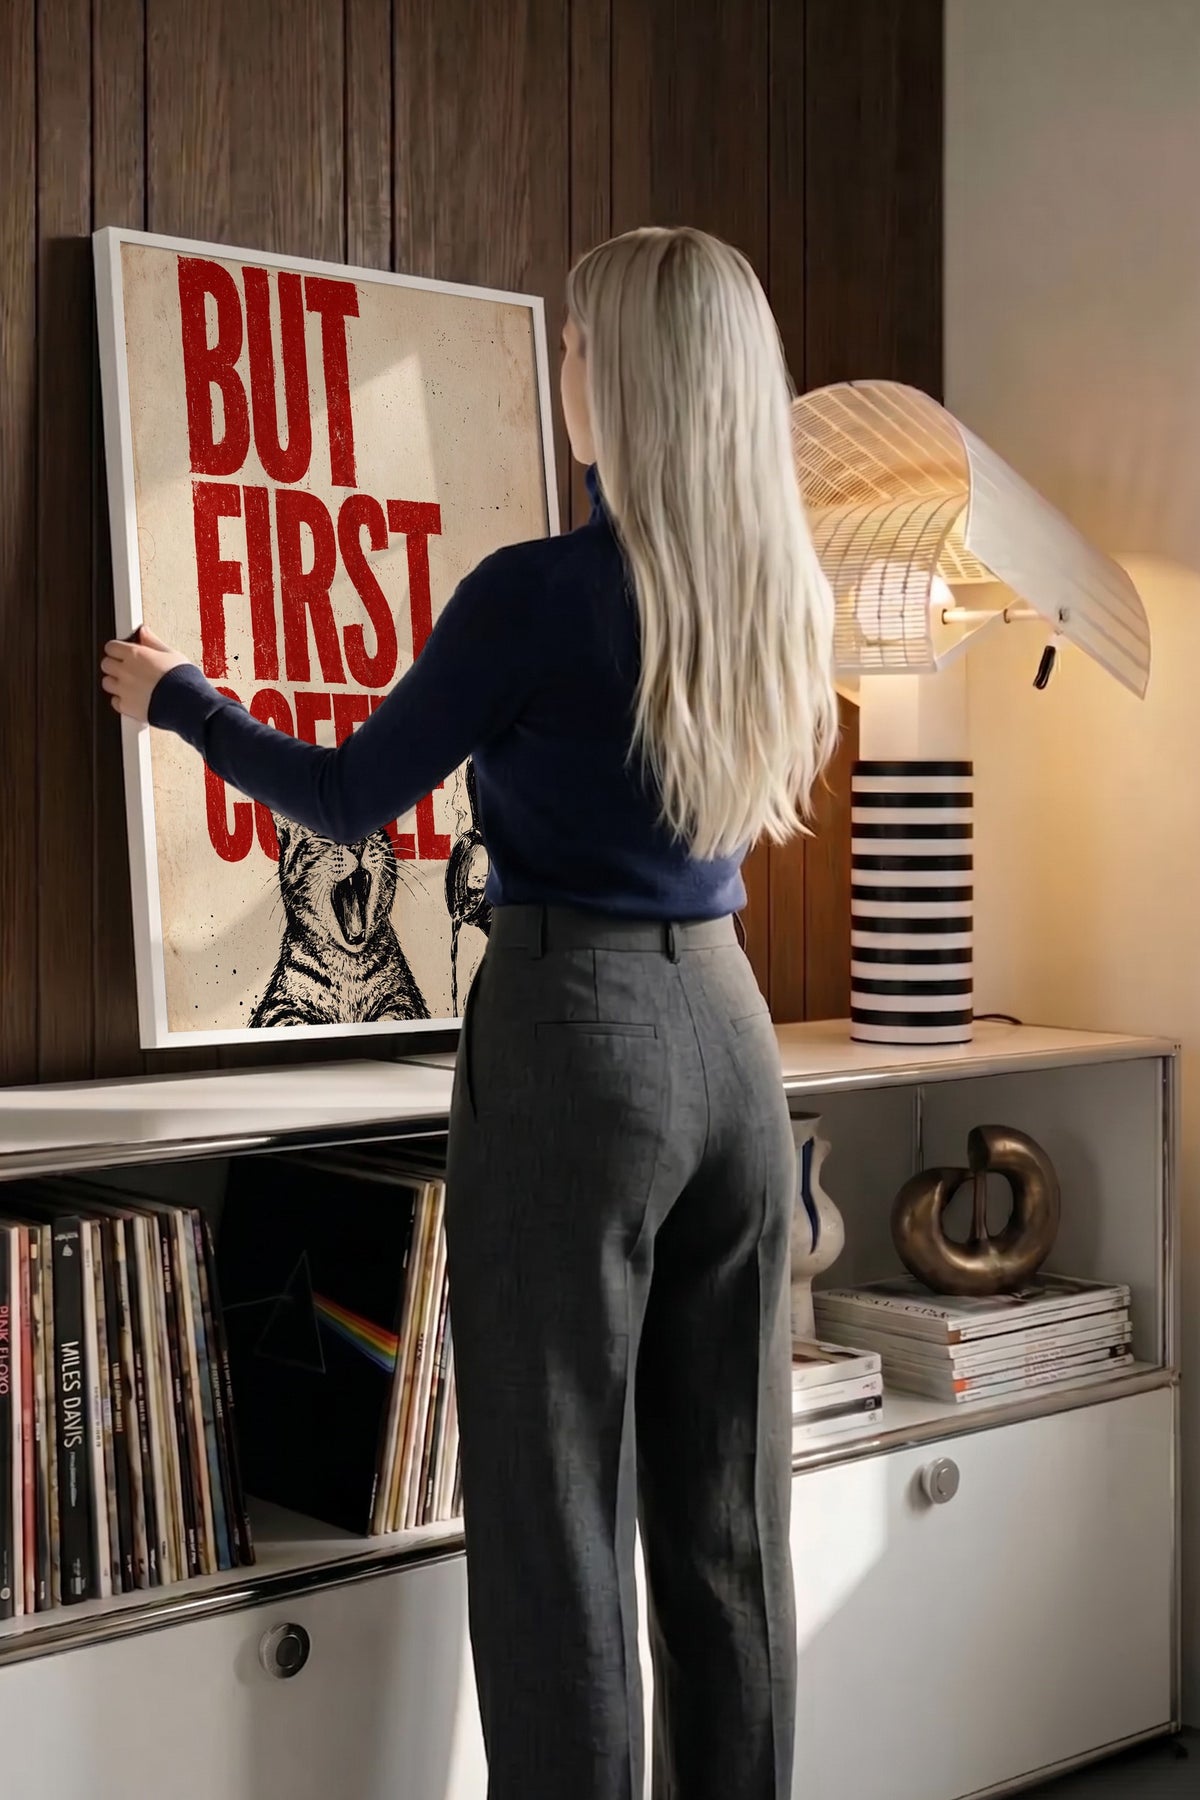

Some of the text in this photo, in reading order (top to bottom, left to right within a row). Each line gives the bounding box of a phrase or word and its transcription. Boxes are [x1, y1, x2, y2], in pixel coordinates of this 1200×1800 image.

[177, 255, 361, 487] BUT
[190, 480, 442, 688] FIRST
[203, 687, 451, 863] COF
[61, 1341, 83, 1448] MILES DAVIS
